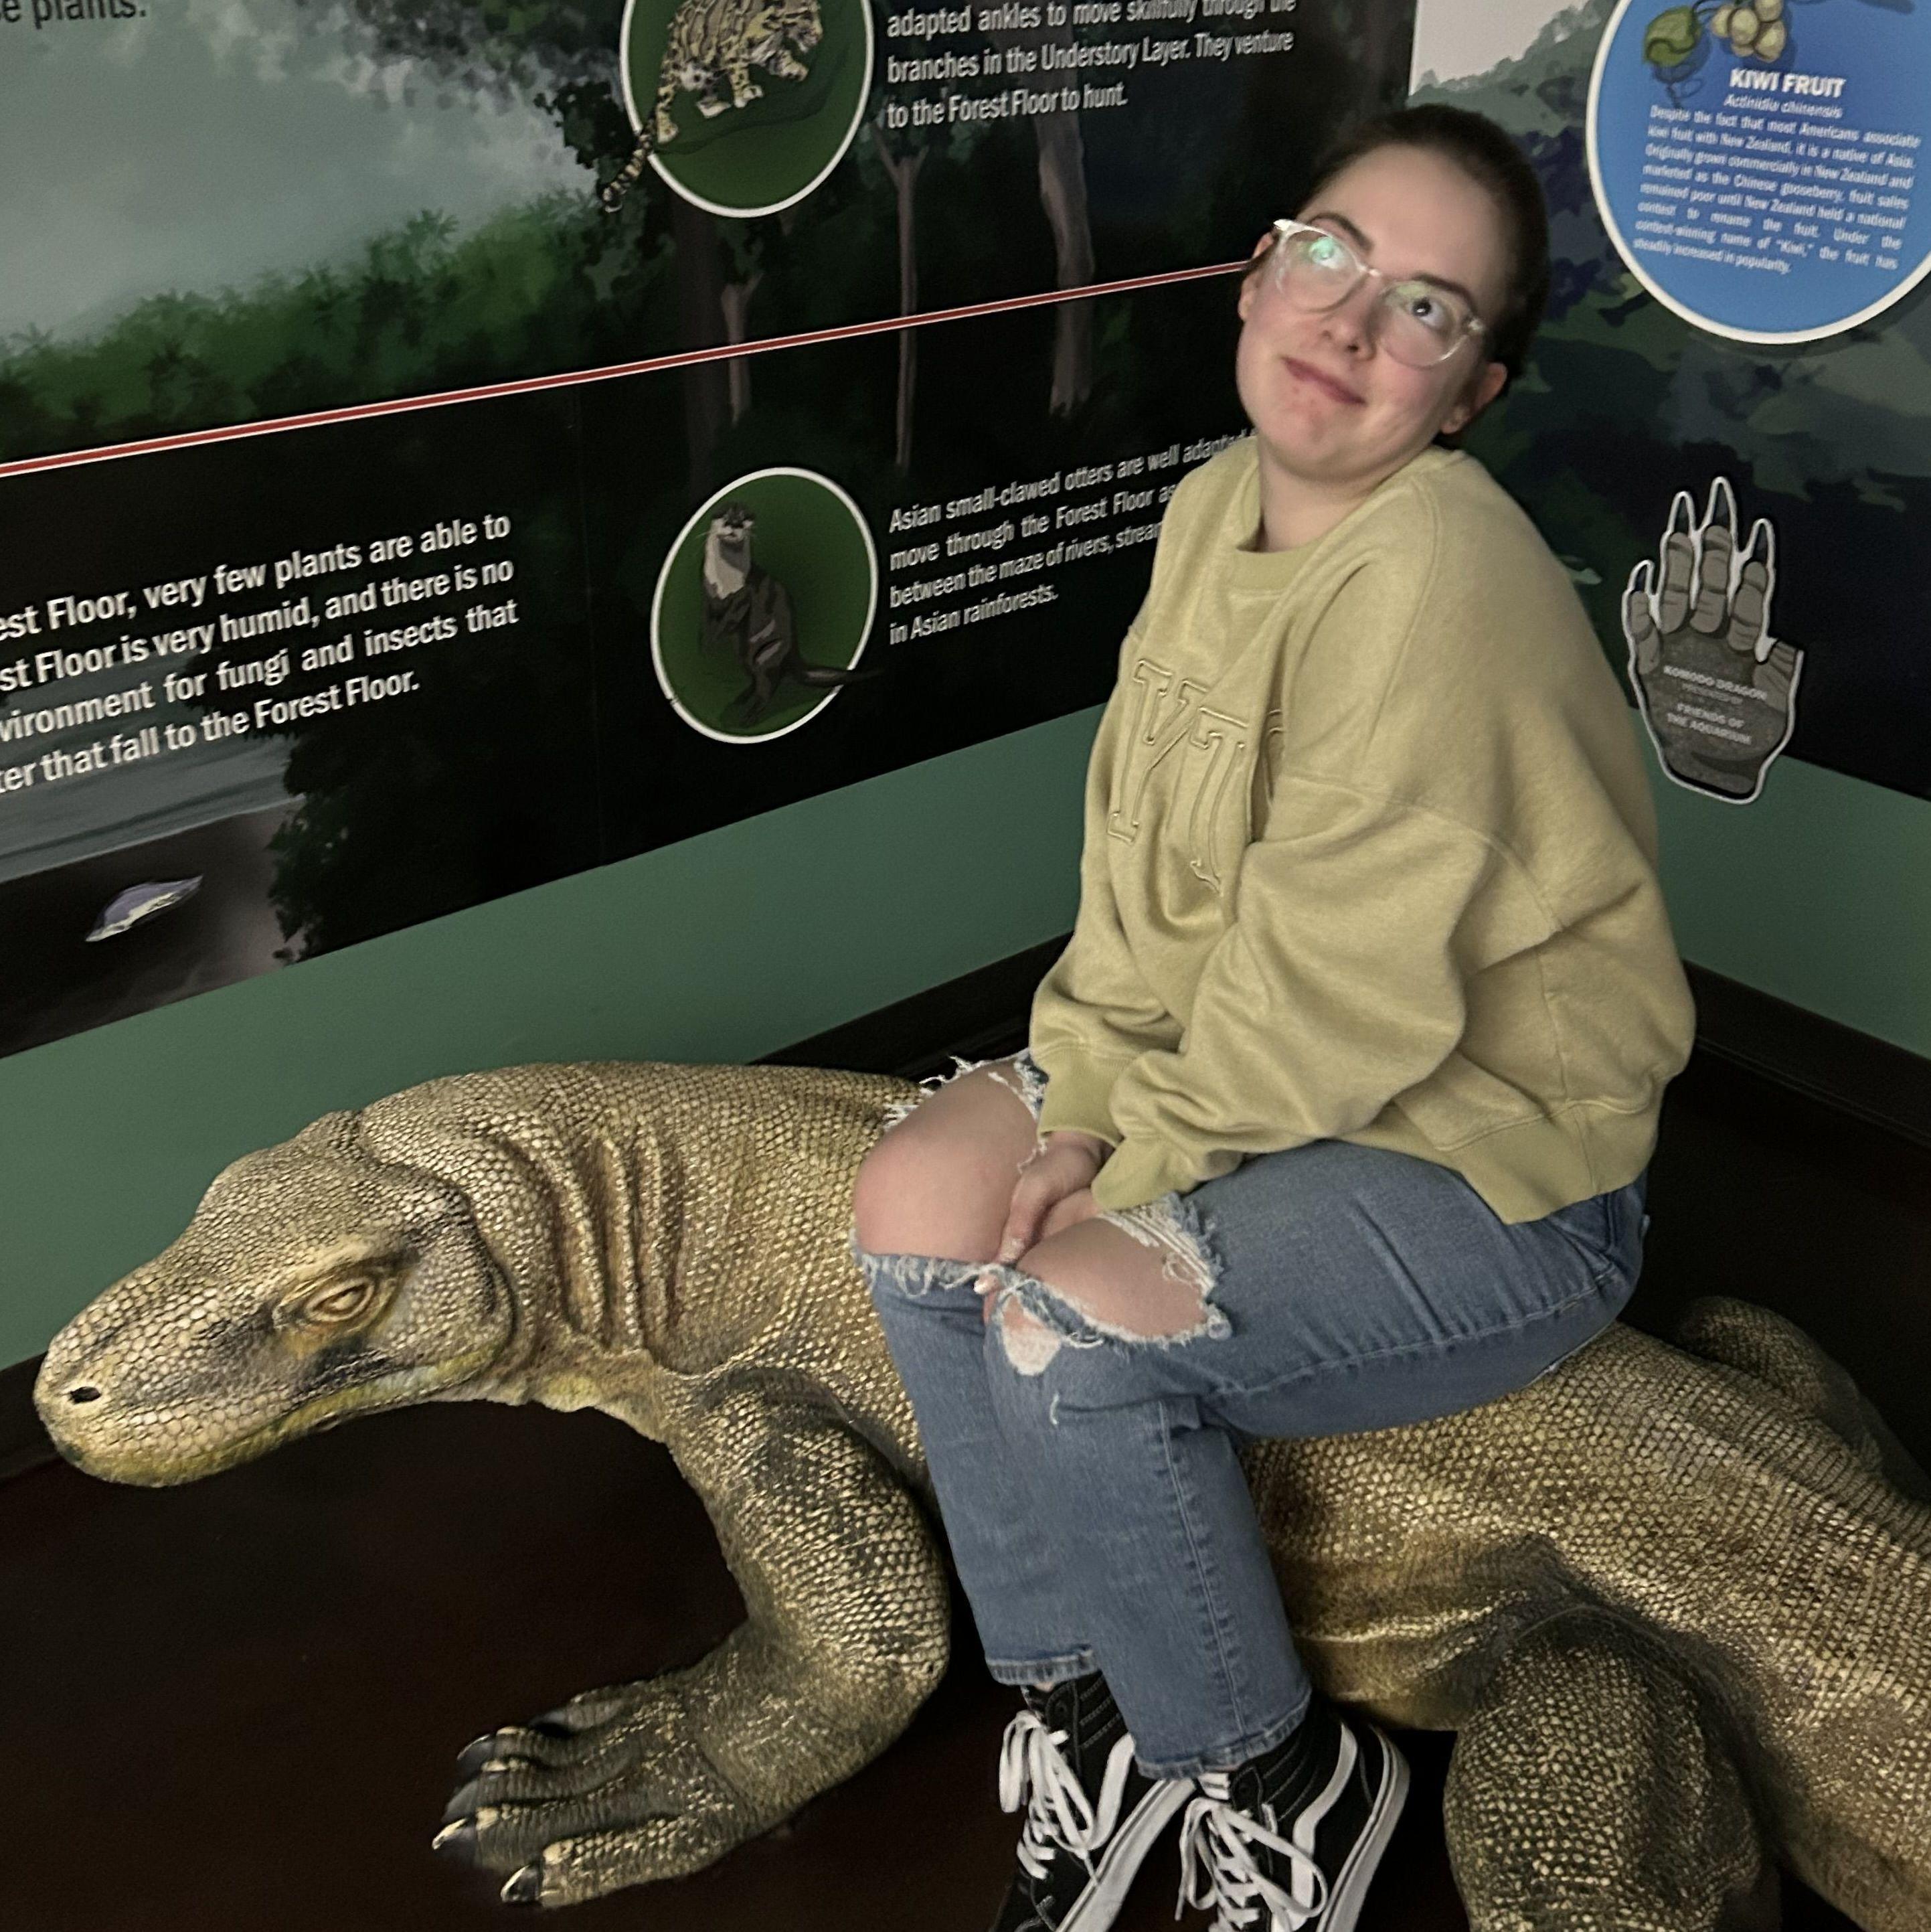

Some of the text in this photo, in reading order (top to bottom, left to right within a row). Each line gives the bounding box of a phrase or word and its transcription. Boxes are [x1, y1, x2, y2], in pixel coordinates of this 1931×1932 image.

[0, 0, 146, 29] e plants.
[888, 5, 972, 42] adapted
[978, 3, 1040, 31] ankles
[1047, 3, 1067, 27] to
[1073, 1, 1122, 25] move
[888, 29, 1294, 84] branches in the Understory Layer. They venture
[888, 81, 1128, 130] to the Forest Floor to hunt.
[1730, 68, 1847, 98] KIWI FRUIT
[1671, 126, 1694, 143] fruit
[1695, 130, 1718, 145] with
[1719, 132, 1745, 148] New
[1796, 142, 1807, 156] it
[1807, 143, 1820, 158] is
[1821, 147, 1831, 159] a
[1832, 147, 1869, 164] native
[1870, 151, 1886, 165] of
[1694, 110, 1712, 124] the
[1715, 112, 1738, 128] fact
[1741, 115, 1764, 131] that
[1767, 120, 1797, 135] most
[1798, 122, 1859, 142] Americans
[1643, 165, 1693, 181] marketed
[1695, 171, 1709, 183] as
[1711, 171, 1732, 186] the
[1734, 173, 1778, 193] Chinese
[1849, 189, 1875, 206] fruit
[1877, 195, 1910, 211] sales
[1645, 143, 1694, 164] Originally
[1728, 155, 1800, 177] commercially
[1800, 164, 1813, 177] in
[1814, 164, 1841, 180] New
[1840, 167, 1890, 187] Zealand
[1888, 175, 1916, 191] and
[1637, 202, 1677, 218] contest
[1687, 206, 1701, 221] to
[1710, 212, 1752, 229] rename
[1762, 218, 1783, 233] the
[1833, 226, 1871, 246] Under
[1881, 235, 1903, 251] the
[1640, 183, 1691, 200] remained
[1717, 193, 1744, 207] until
[1744, 194, 1770, 211] New
[1770, 198, 1817, 218] Zealand
[1817, 206, 1845, 222] held
[1845, 212, 1855, 224] a
[1857, 212, 1907, 230] national
[1721, 233, 1752, 248] name
[1757, 236, 1772, 250] of
[1819, 245, 1840, 261] the
[1845, 248, 1871, 266] fruit
[1875, 255, 1899, 271] has
[890, 503, 940, 534] Asian
[946, 471, 1061, 519] small-clawed
[1065, 471, 1113, 491] otters
[1117, 456, 1145, 478] are
[1148, 444, 1180, 471] well
[890, 541, 940, 572] move
[946, 521, 1015, 552] through
[1020, 512, 1050, 538] the
[1055, 497, 1108, 530] Forest
[1112, 489, 1156, 515] Floor
[47, 592, 137, 630] Floor,
[143, 574, 208, 608] very
[214, 562, 267, 596] few
[274, 542, 362, 588] plants
[368, 534, 414, 564] are
[420, 519, 478, 554] able
[483, 513, 511, 540] to
[890, 572, 966, 609] between
[968, 563, 997, 587] the
[999, 552, 1045, 580] maze
[1045, 543, 1064, 566] of
[1064, 534, 1114, 562] rivers,
[35, 644, 116, 683] Floor
[120, 633, 150, 663] is
[152, 622, 216, 655] very
[220, 600, 321, 643] humid,
[325, 581, 377, 620] and
[382, 567, 450, 607] there
[454, 562, 478, 592] is
[482, 557, 515, 586] no
[890, 582, 1059, 645] in Asian rainforests.
[163, 669, 208, 704] for
[216, 648, 290, 692] fungi
[301, 634, 355, 672] and
[364, 615, 457, 657] insects
[466, 598, 519, 633] that
[1663, 665, 1768, 701] KOMODO DRAGON
[40, 742, 110, 784] that
[110, 726, 161, 765] fall
[164, 722, 197, 751] to
[200, 710, 251, 743] the
[254, 684, 343, 730] Forest
[345, 669, 420, 707] Floor.
[1728, 717, 1744, 728] OF
